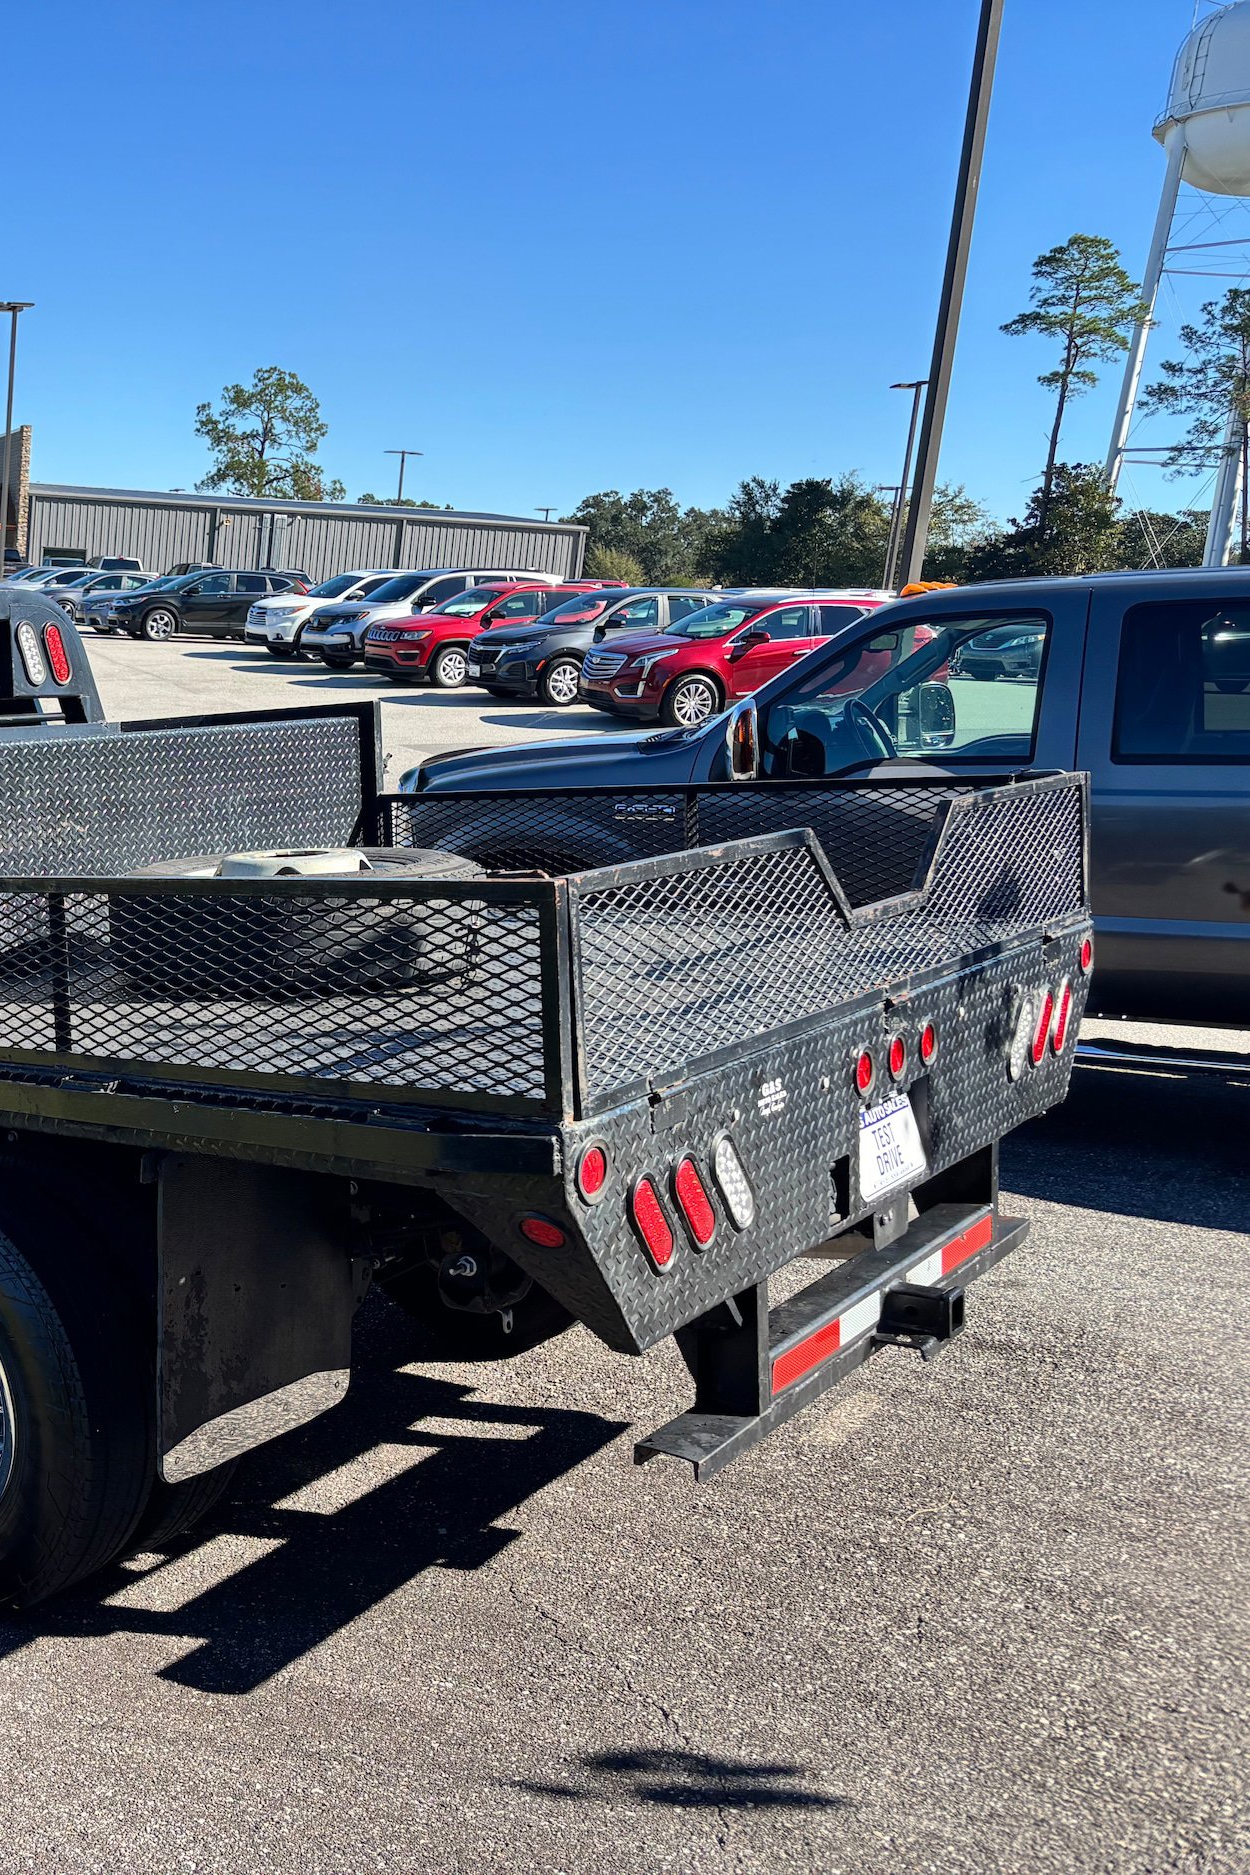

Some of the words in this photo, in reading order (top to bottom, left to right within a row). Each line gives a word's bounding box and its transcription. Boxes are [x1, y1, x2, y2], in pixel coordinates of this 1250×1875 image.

[864, 1104, 886, 1126] AUTO
[884, 1093, 909, 1115] SALES
[871, 1122, 895, 1151] TEST
[876, 1144, 904, 1176] DRIVE
